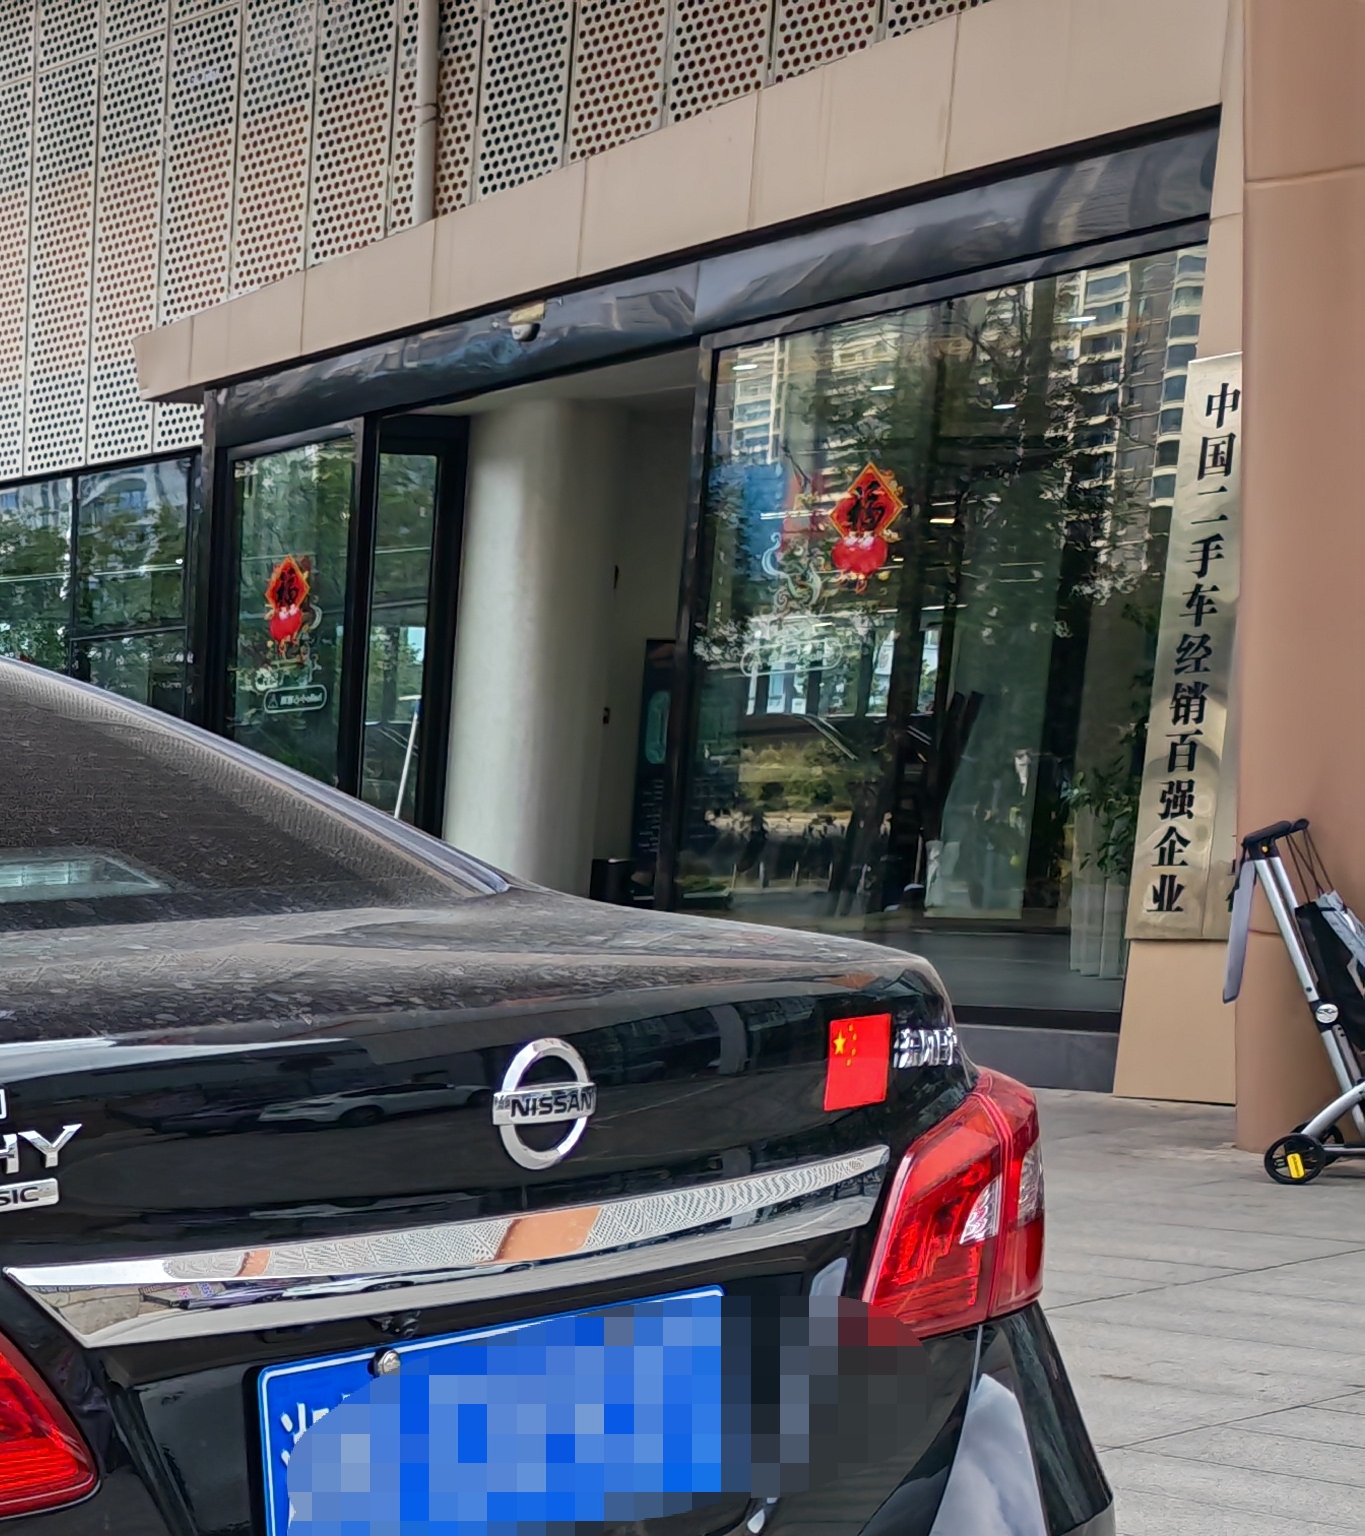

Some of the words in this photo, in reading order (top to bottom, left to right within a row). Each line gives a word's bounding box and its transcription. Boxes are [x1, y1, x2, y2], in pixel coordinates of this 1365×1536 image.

[1146, 382, 1241, 912] 中国二手车经销百强企业
[510, 1089, 592, 1118] NISSAN
